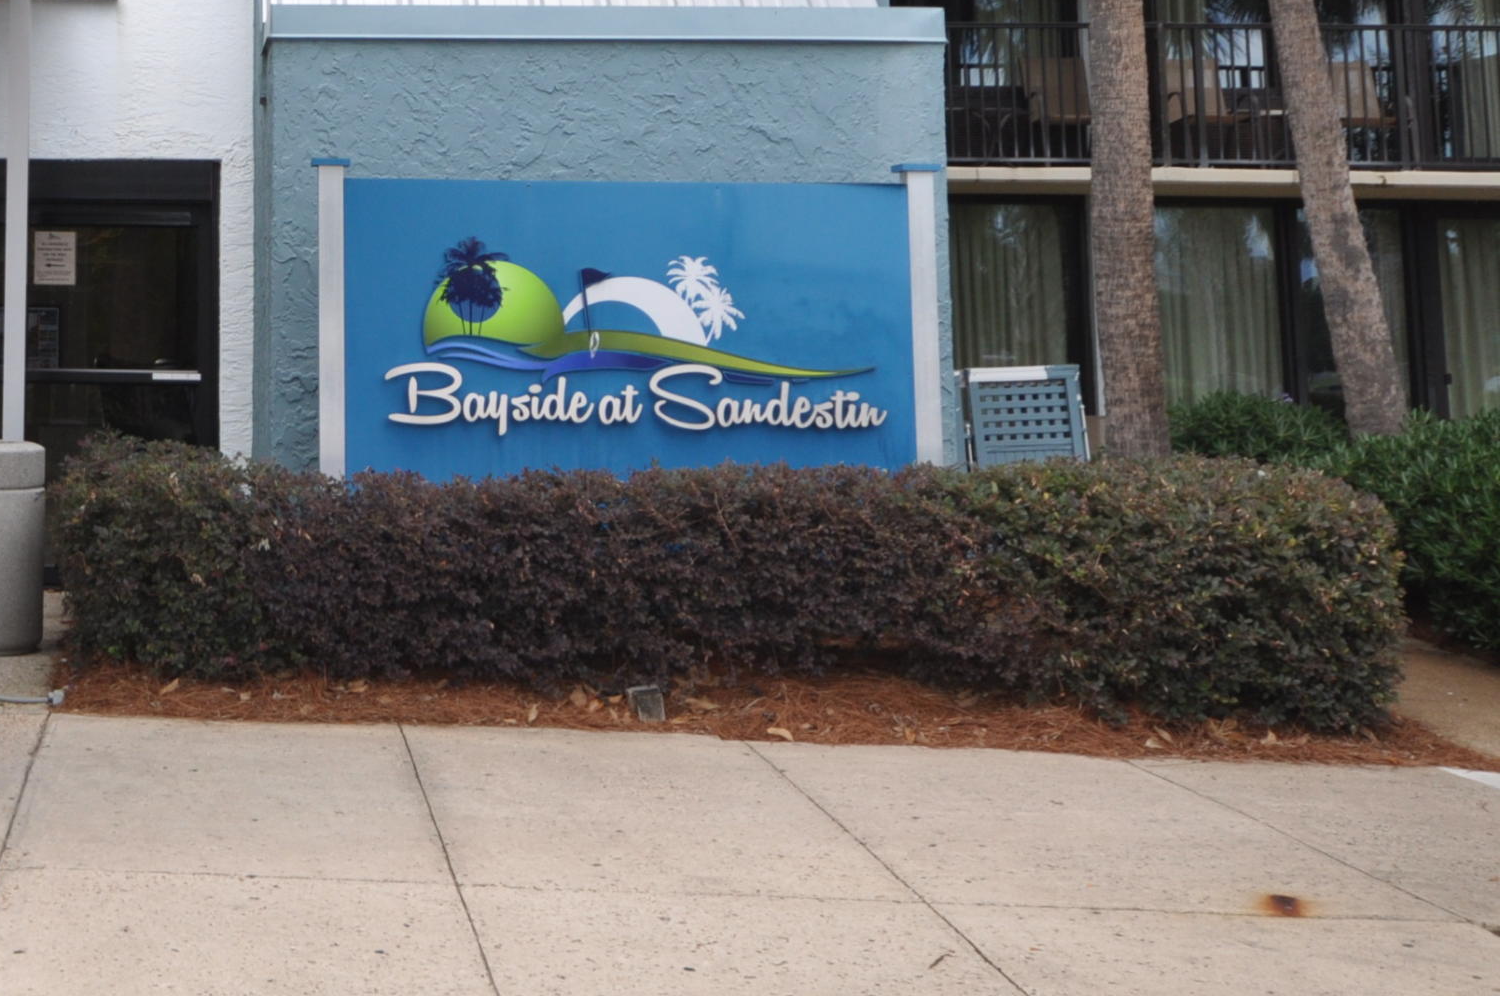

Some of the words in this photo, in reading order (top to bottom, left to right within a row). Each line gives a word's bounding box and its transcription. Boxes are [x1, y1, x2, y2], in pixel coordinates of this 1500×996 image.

[384, 362, 595, 436] Bayside
[598, 384, 643, 425] at
[649, 363, 888, 431] Sandestin
